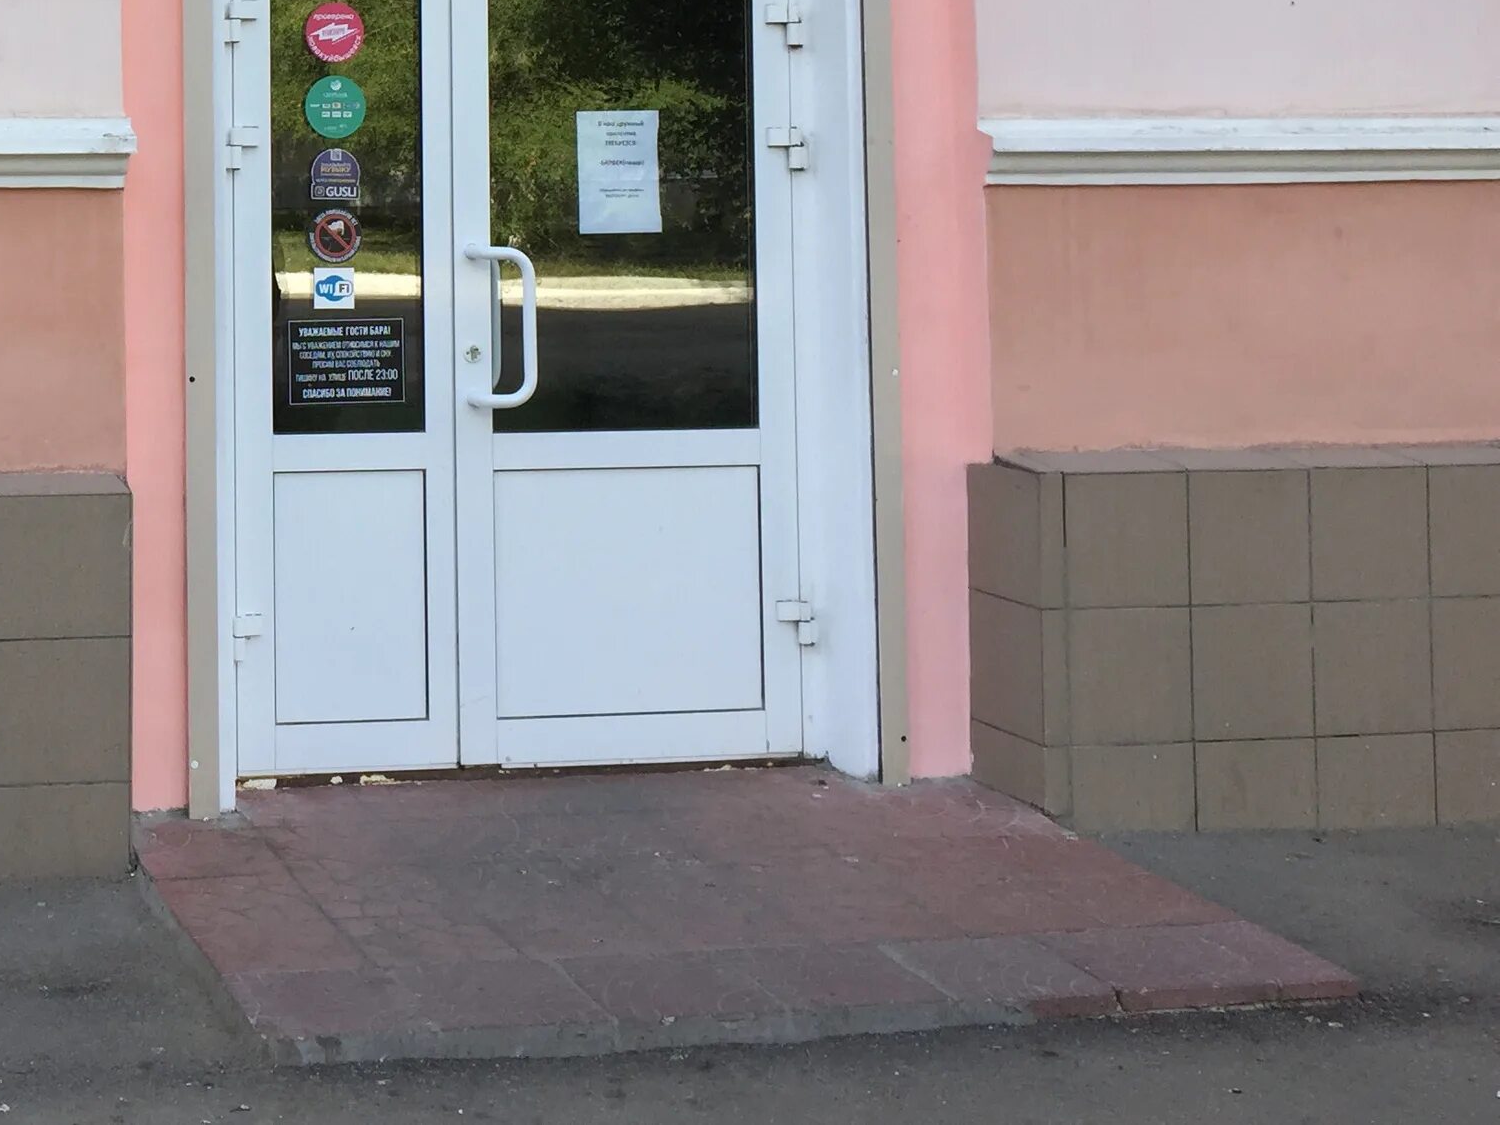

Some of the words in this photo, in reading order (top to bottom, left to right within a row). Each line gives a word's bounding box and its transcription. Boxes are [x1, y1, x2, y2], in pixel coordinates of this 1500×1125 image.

[326, 186, 357, 198] GUSLI
[345, 326, 368, 336] ГОСТИ
[369, 325, 391, 336] БАРА!
[348, 369, 374, 381] ПОСЛЕ
[375, 368, 398, 380] 23:00
[302, 388, 335, 399] СПАСИБО
[336, 388, 346, 397] ЗА
